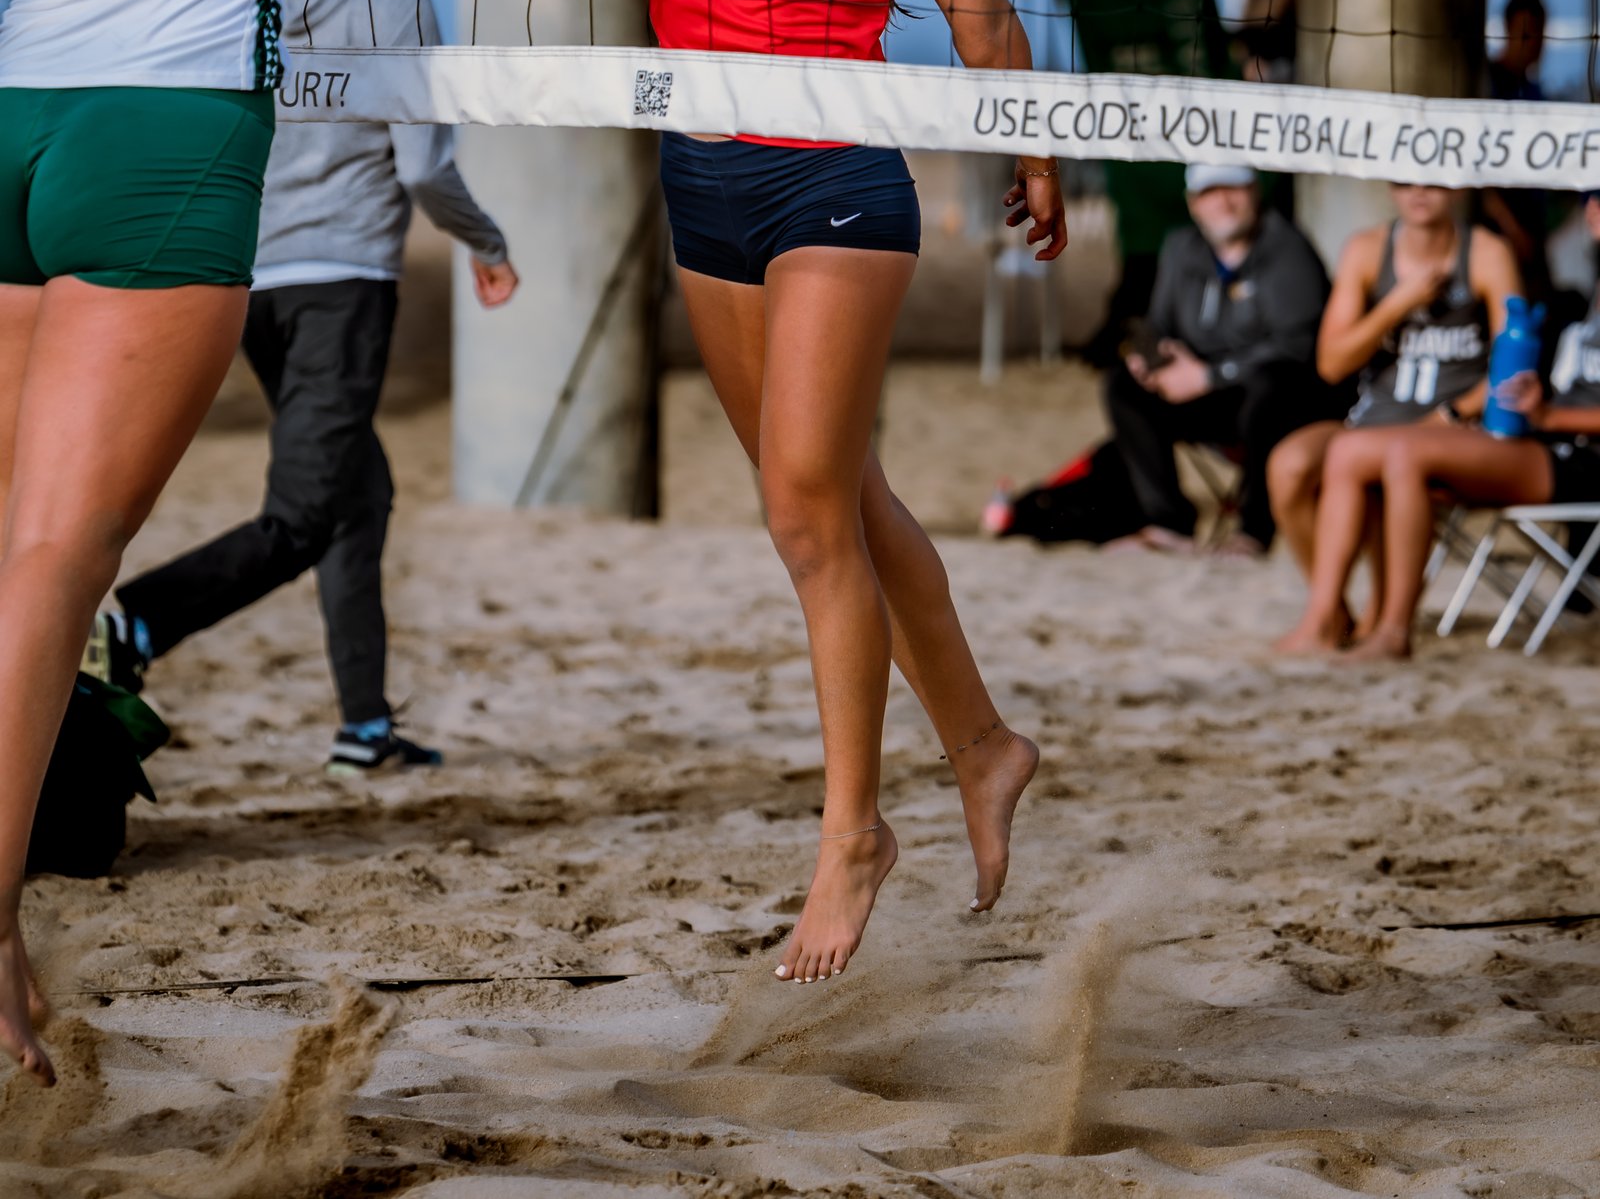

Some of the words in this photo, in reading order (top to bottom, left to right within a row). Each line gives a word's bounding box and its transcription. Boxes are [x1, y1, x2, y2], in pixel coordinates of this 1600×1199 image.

[279, 71, 351, 108] URT!
[974, 98, 1039, 137] USE
[1048, 101, 1147, 142] CODE:
[1161, 105, 1378, 161] VOLLEYBALL
[1391, 124, 1465, 168] FOR
[1473, 125, 1514, 172] $5
[1525, 130, 1600, 170] OFF
[1393, 355, 1440, 405] 11
